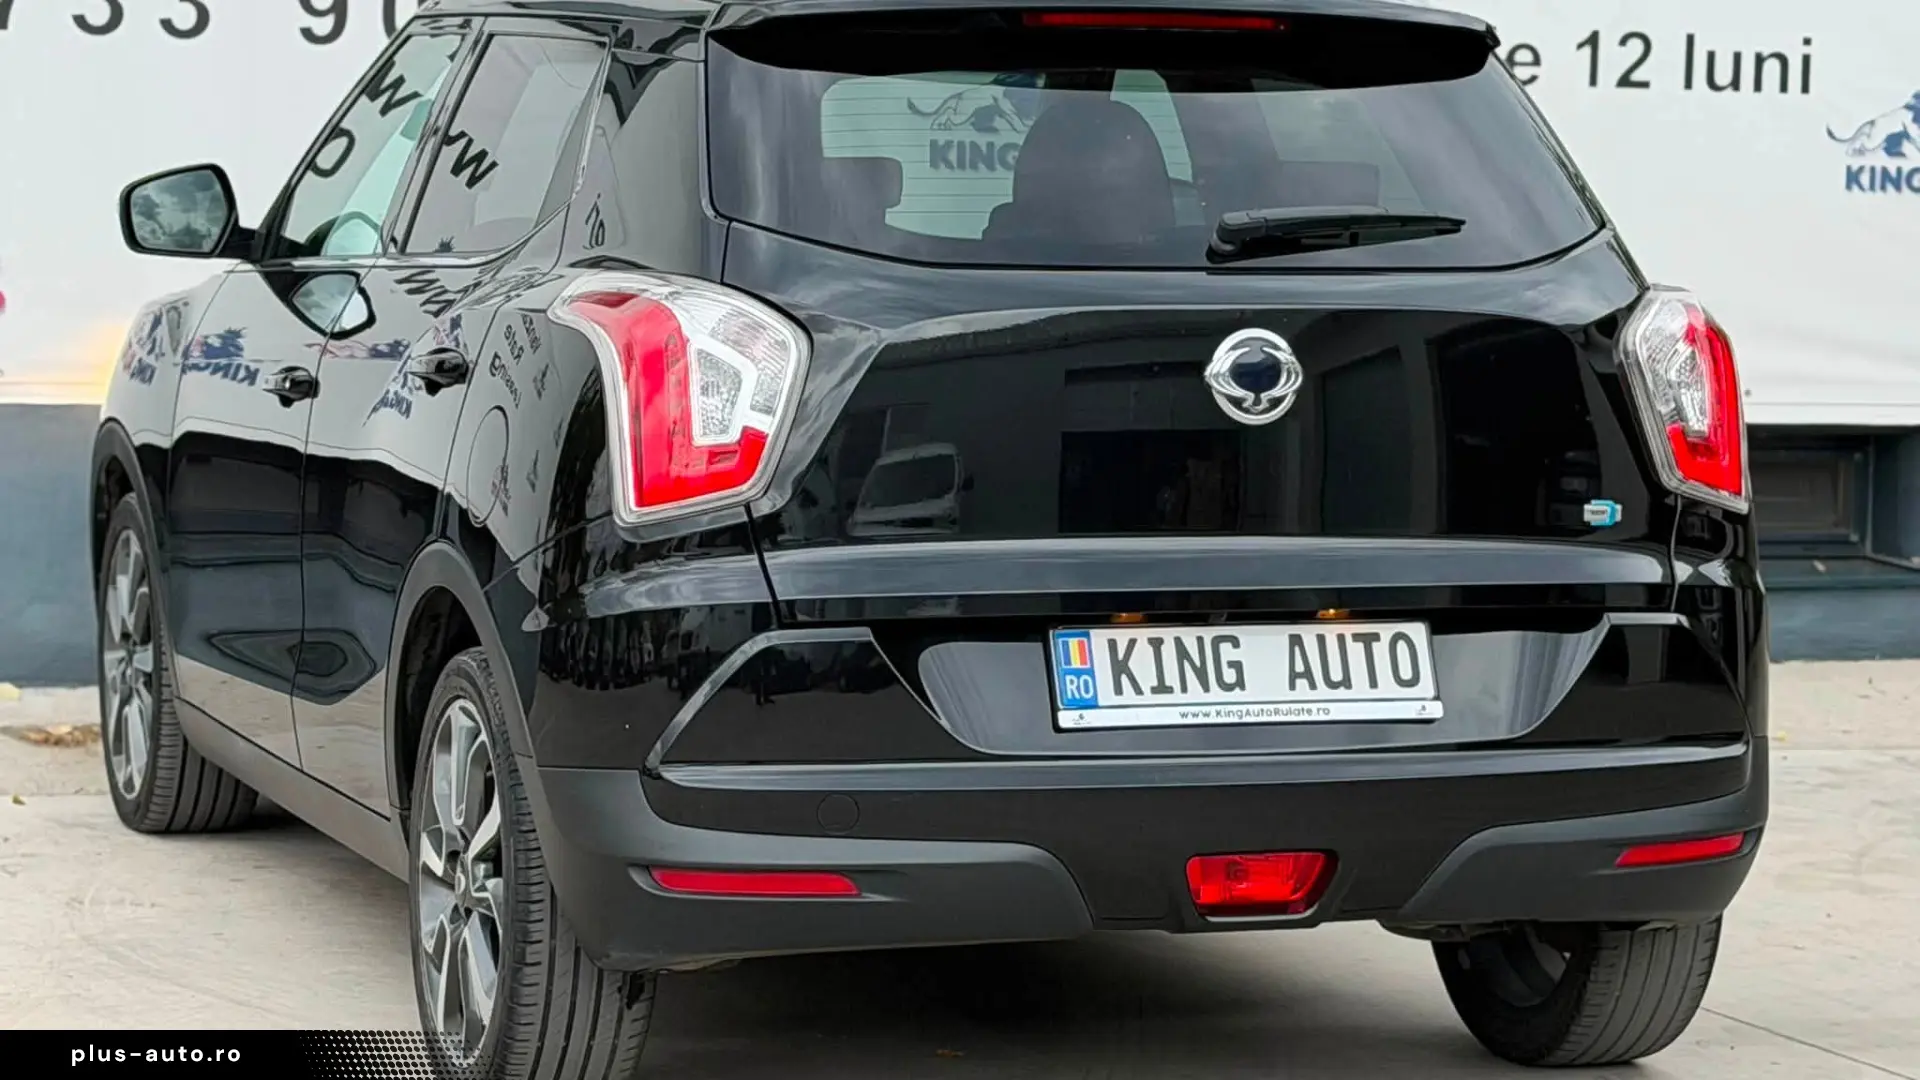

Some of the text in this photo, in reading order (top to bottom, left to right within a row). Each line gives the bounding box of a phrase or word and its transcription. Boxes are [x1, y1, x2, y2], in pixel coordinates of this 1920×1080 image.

[1575, 29, 1652, 89] 12
[1683, 33, 1812, 94] luni
[1065, 631, 1421, 700] RO KING AUTO
[1178, 706, 1331, 720] www.KingAutoRulate.ro
